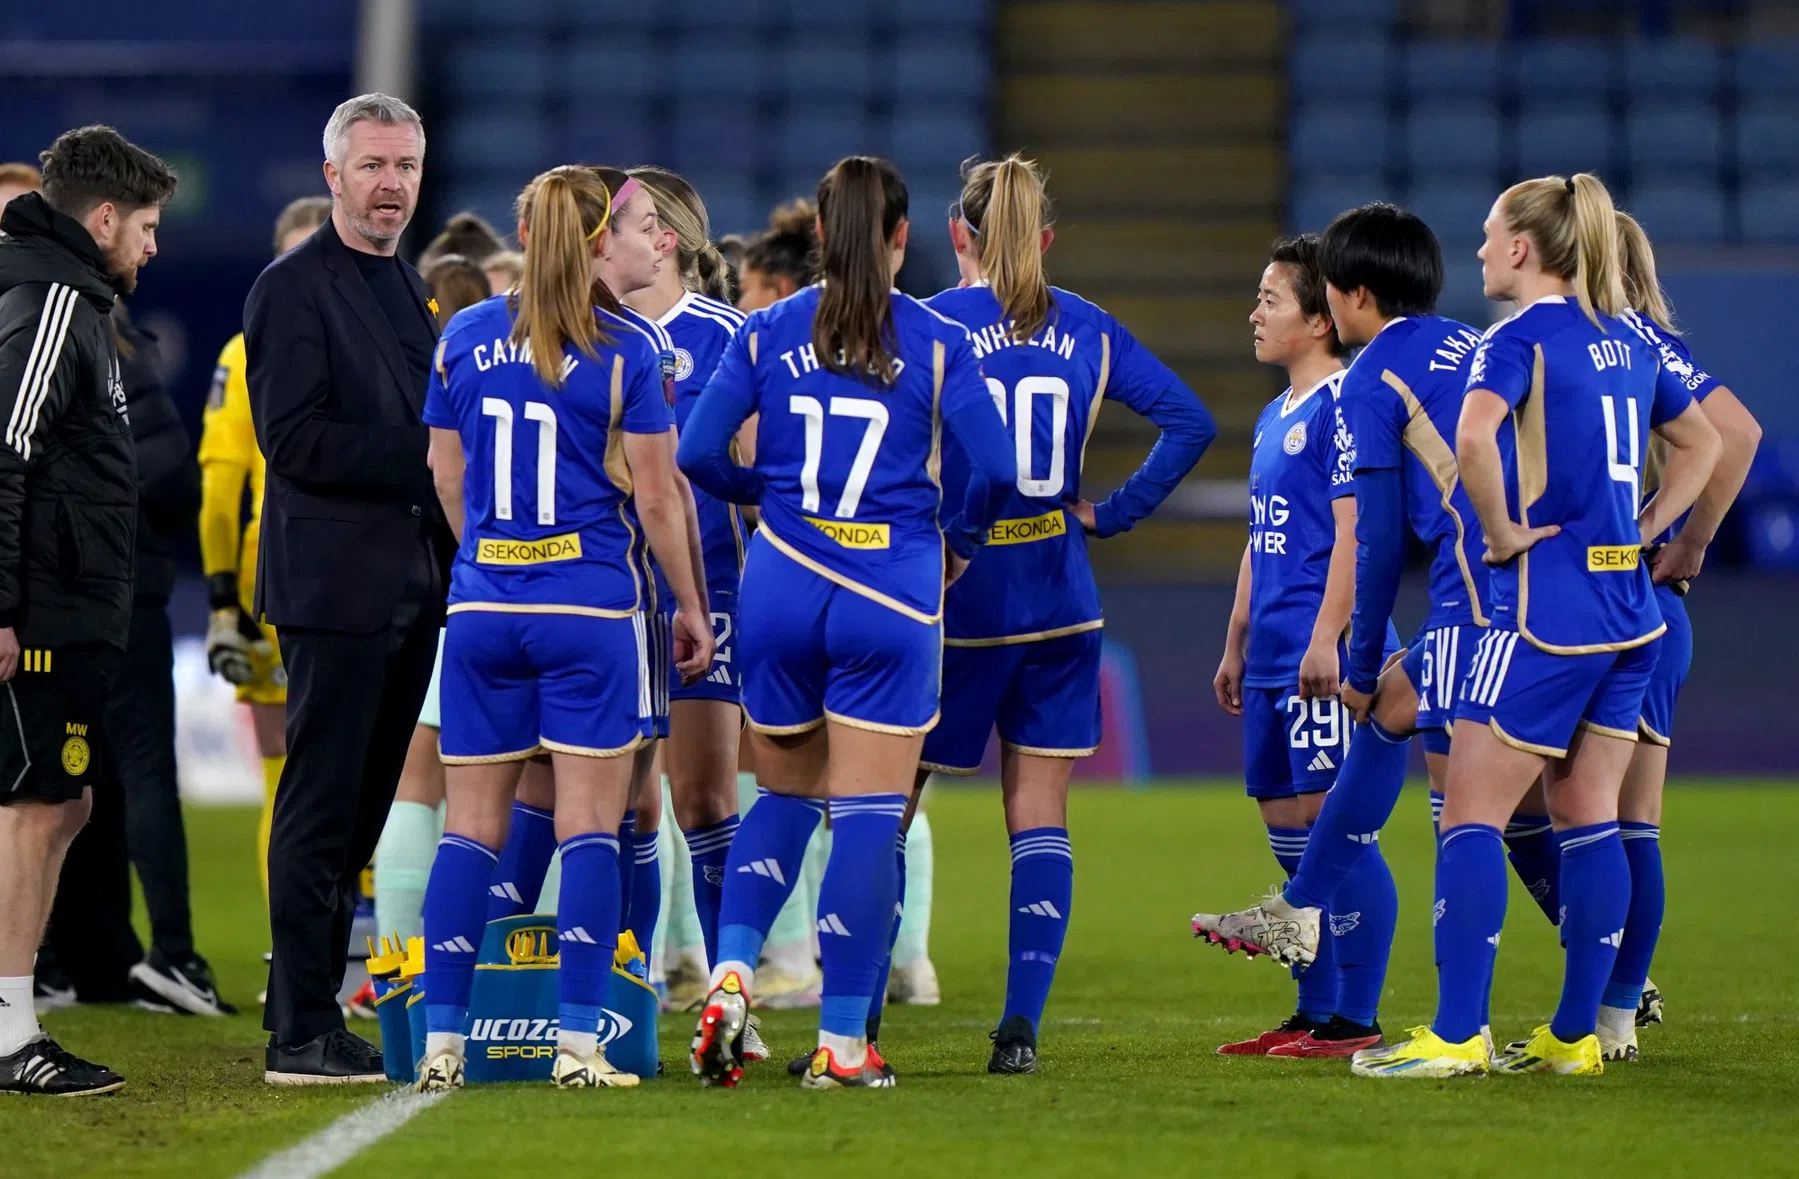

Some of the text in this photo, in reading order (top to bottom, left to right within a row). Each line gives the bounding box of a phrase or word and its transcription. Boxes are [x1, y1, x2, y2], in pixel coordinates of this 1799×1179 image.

[473, 337, 579, 382] CAYMN
[1429, 329, 1481, 371] TAKA
[1587, 339, 1631, 371] BOTT
[482, 397, 557, 525] 11
[790, 395, 889, 518] 17
[1601, 395, 1638, 520] 4
[818, 524, 884, 544] ONDA
[991, 516, 1062, 540] EKONDA
[483, 540, 575, 560] SEKONDA
[1592, 549, 1637, 566] SEKO
[66, 721, 88, 736] MW
[1287, 693, 1339, 748] 29
